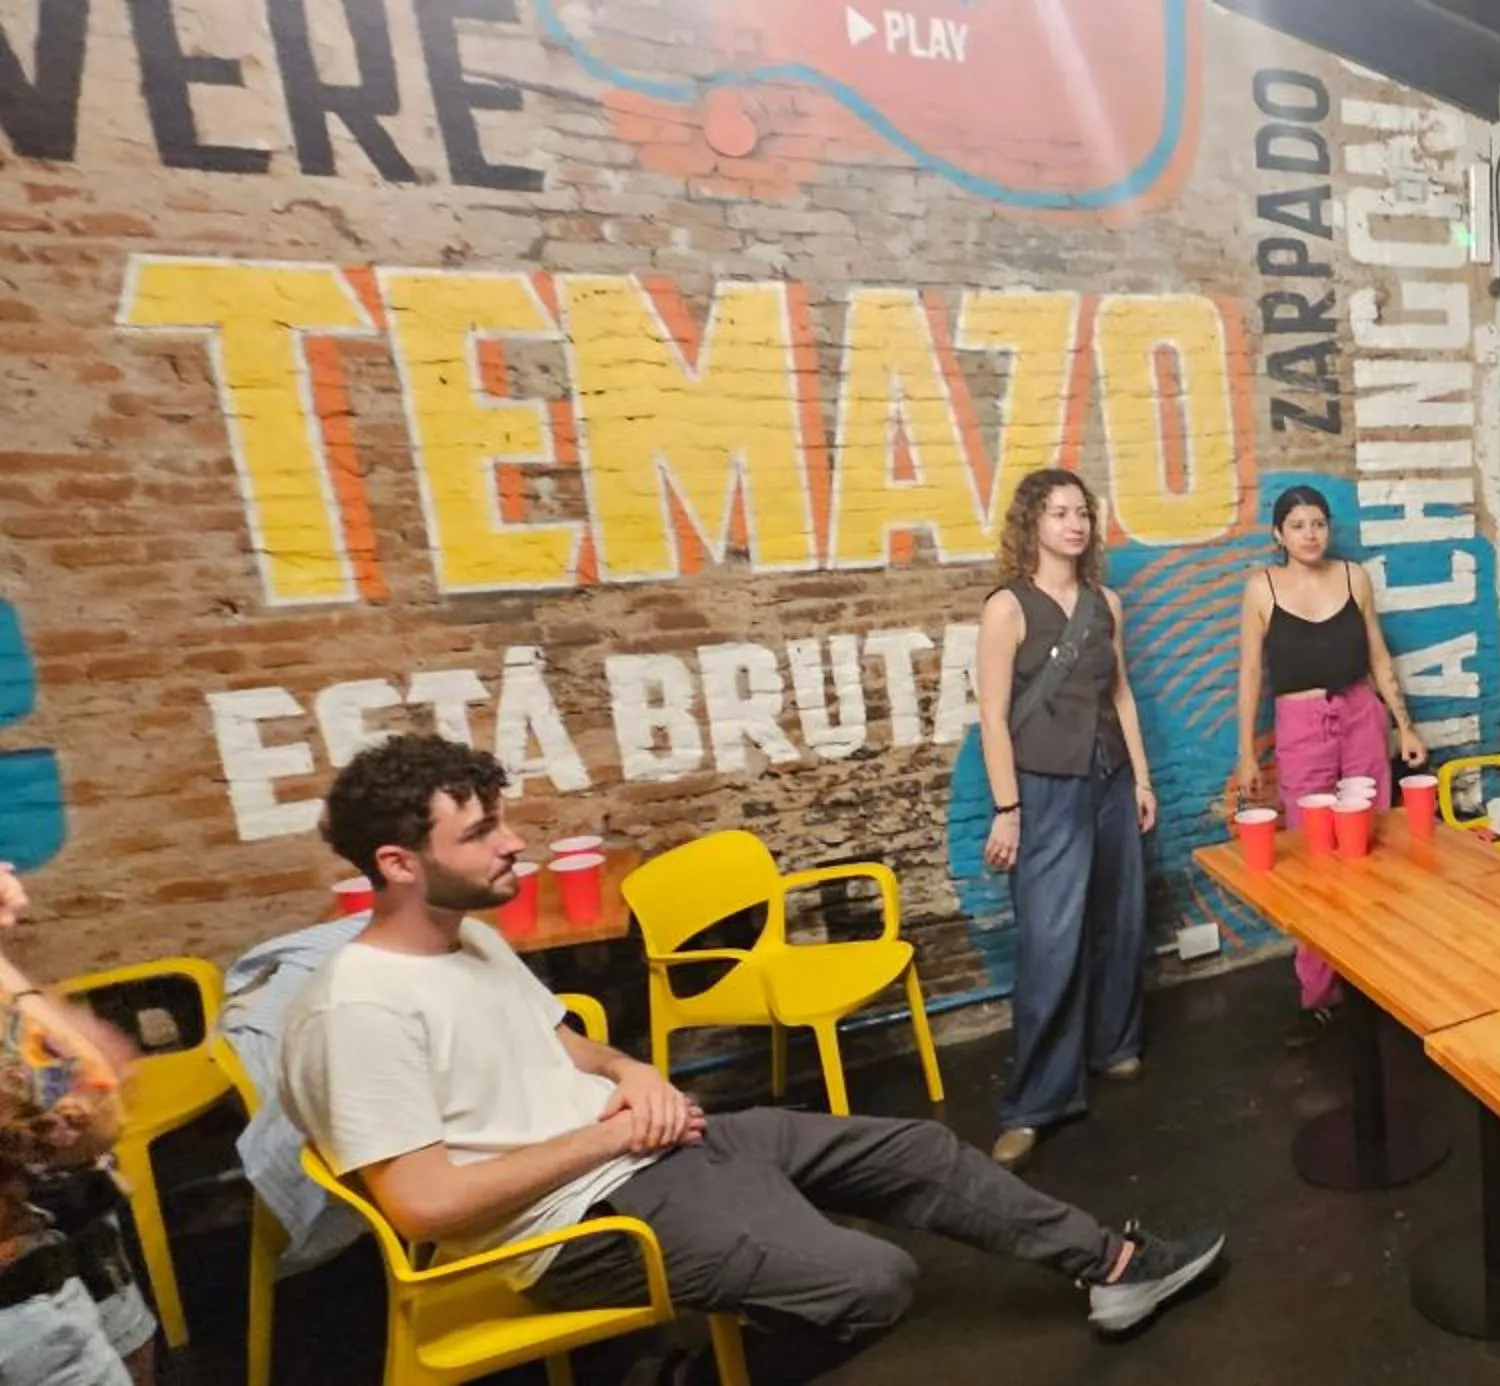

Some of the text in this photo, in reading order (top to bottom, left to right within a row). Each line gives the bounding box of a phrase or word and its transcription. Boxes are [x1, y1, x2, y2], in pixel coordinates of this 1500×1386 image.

[881, 9, 967, 63] PLAY
[1252, 68, 1342, 435] ZARPADO
[114, 252, 1244, 608] TEMAZO
